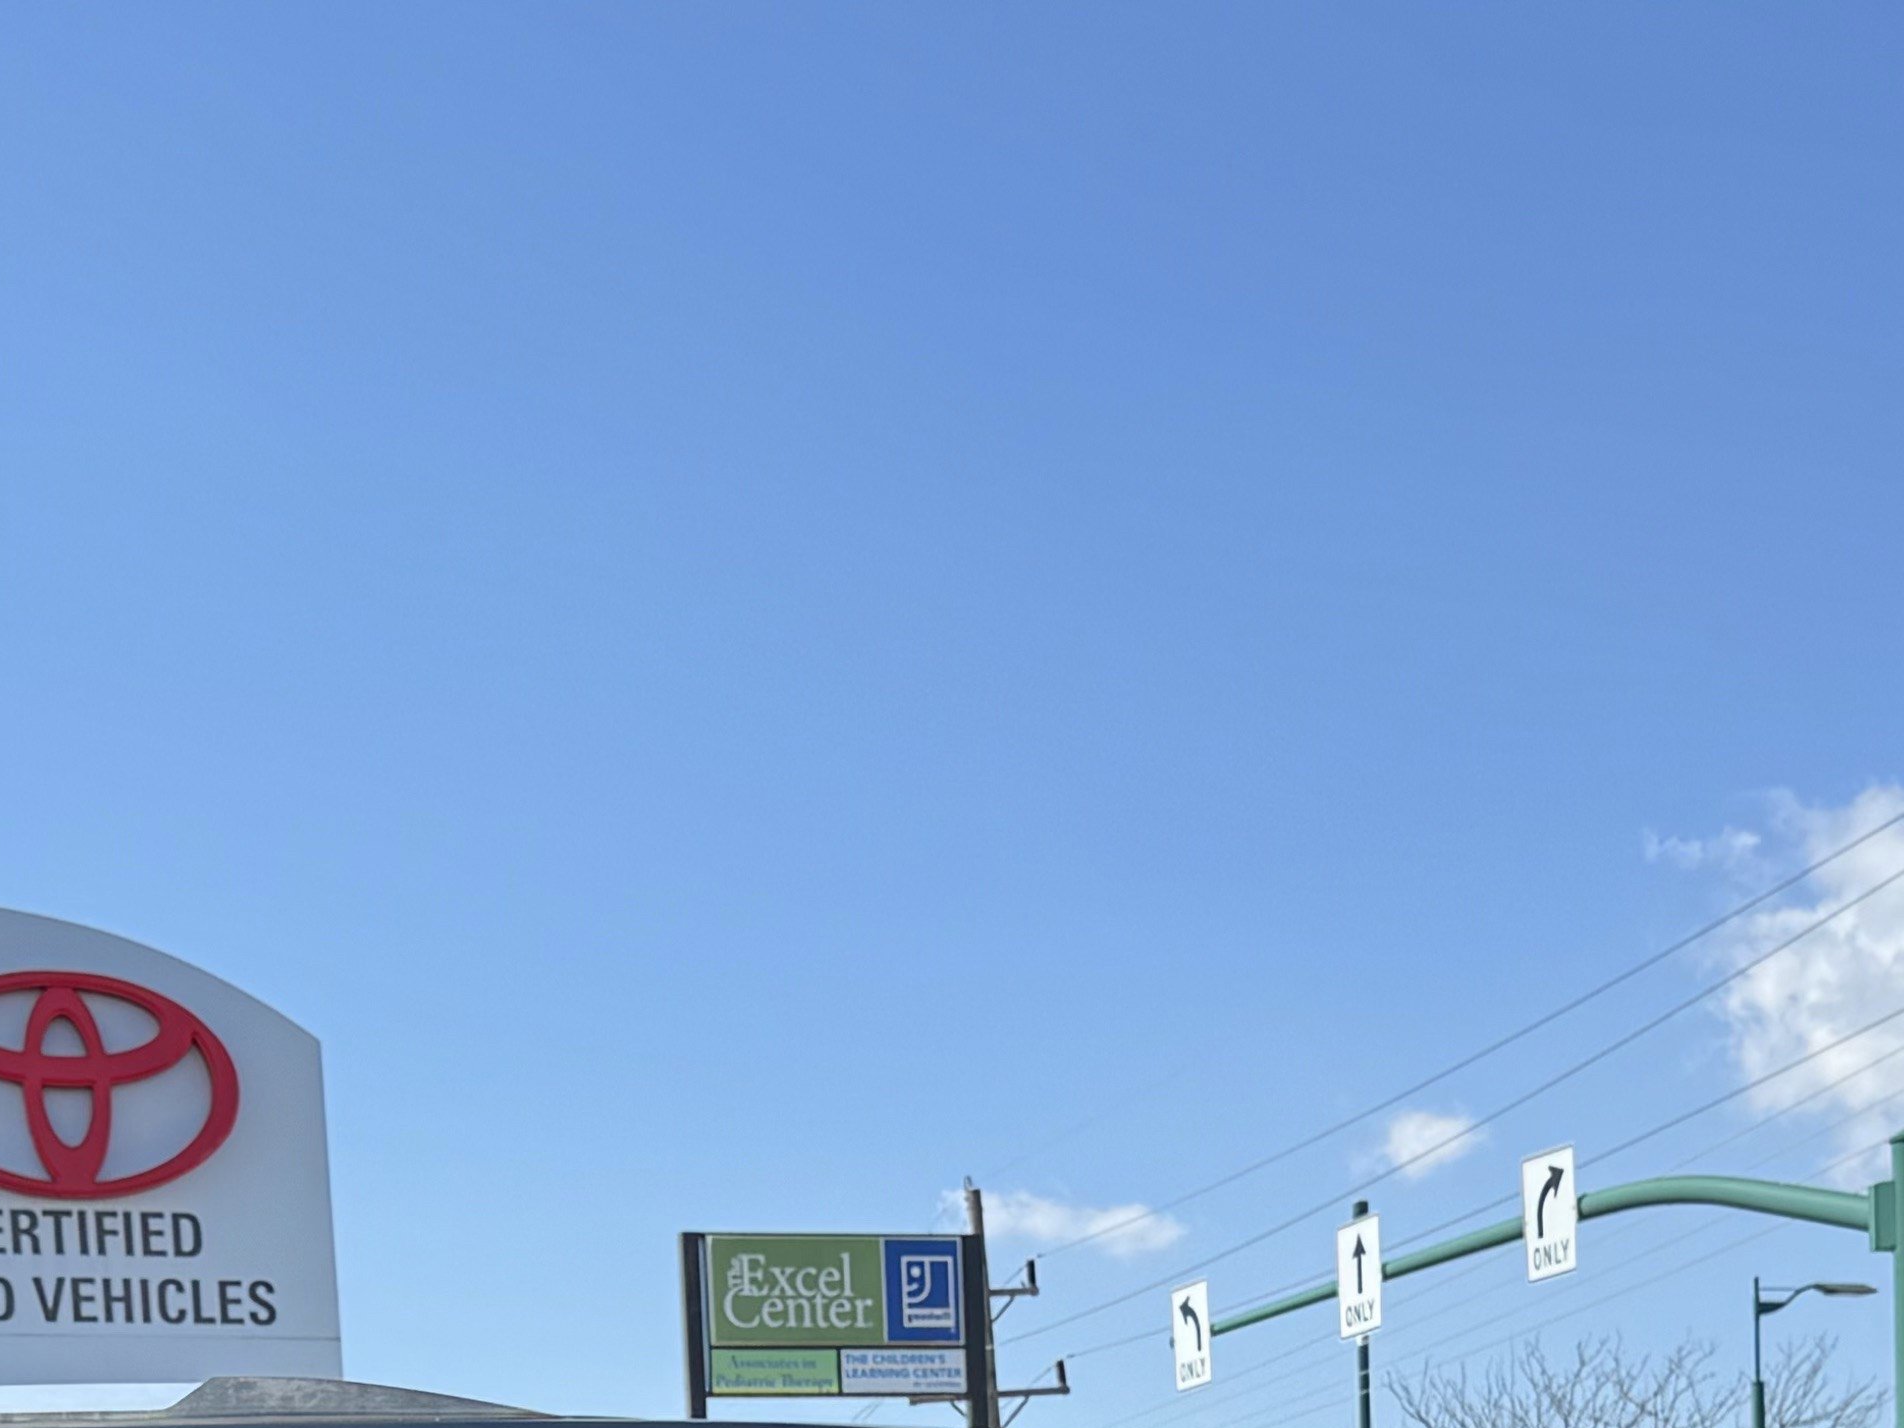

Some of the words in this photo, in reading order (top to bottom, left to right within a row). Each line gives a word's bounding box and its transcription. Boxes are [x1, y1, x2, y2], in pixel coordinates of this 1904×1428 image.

[1533, 1237, 1571, 1271] ONLY
[736, 1252, 854, 1297] Excel
[32, 1277, 278, 1326] VEHICLES
[723, 1287, 873, 1330] Center
[1345, 1298, 1376, 1328] ONLY
[845, 1354, 869, 1365] THE
[845, 1368, 910, 1379] LEARNING
[913, 1368, 962, 1379] CENTER
[1179, 1358, 1206, 1383] ONLY
